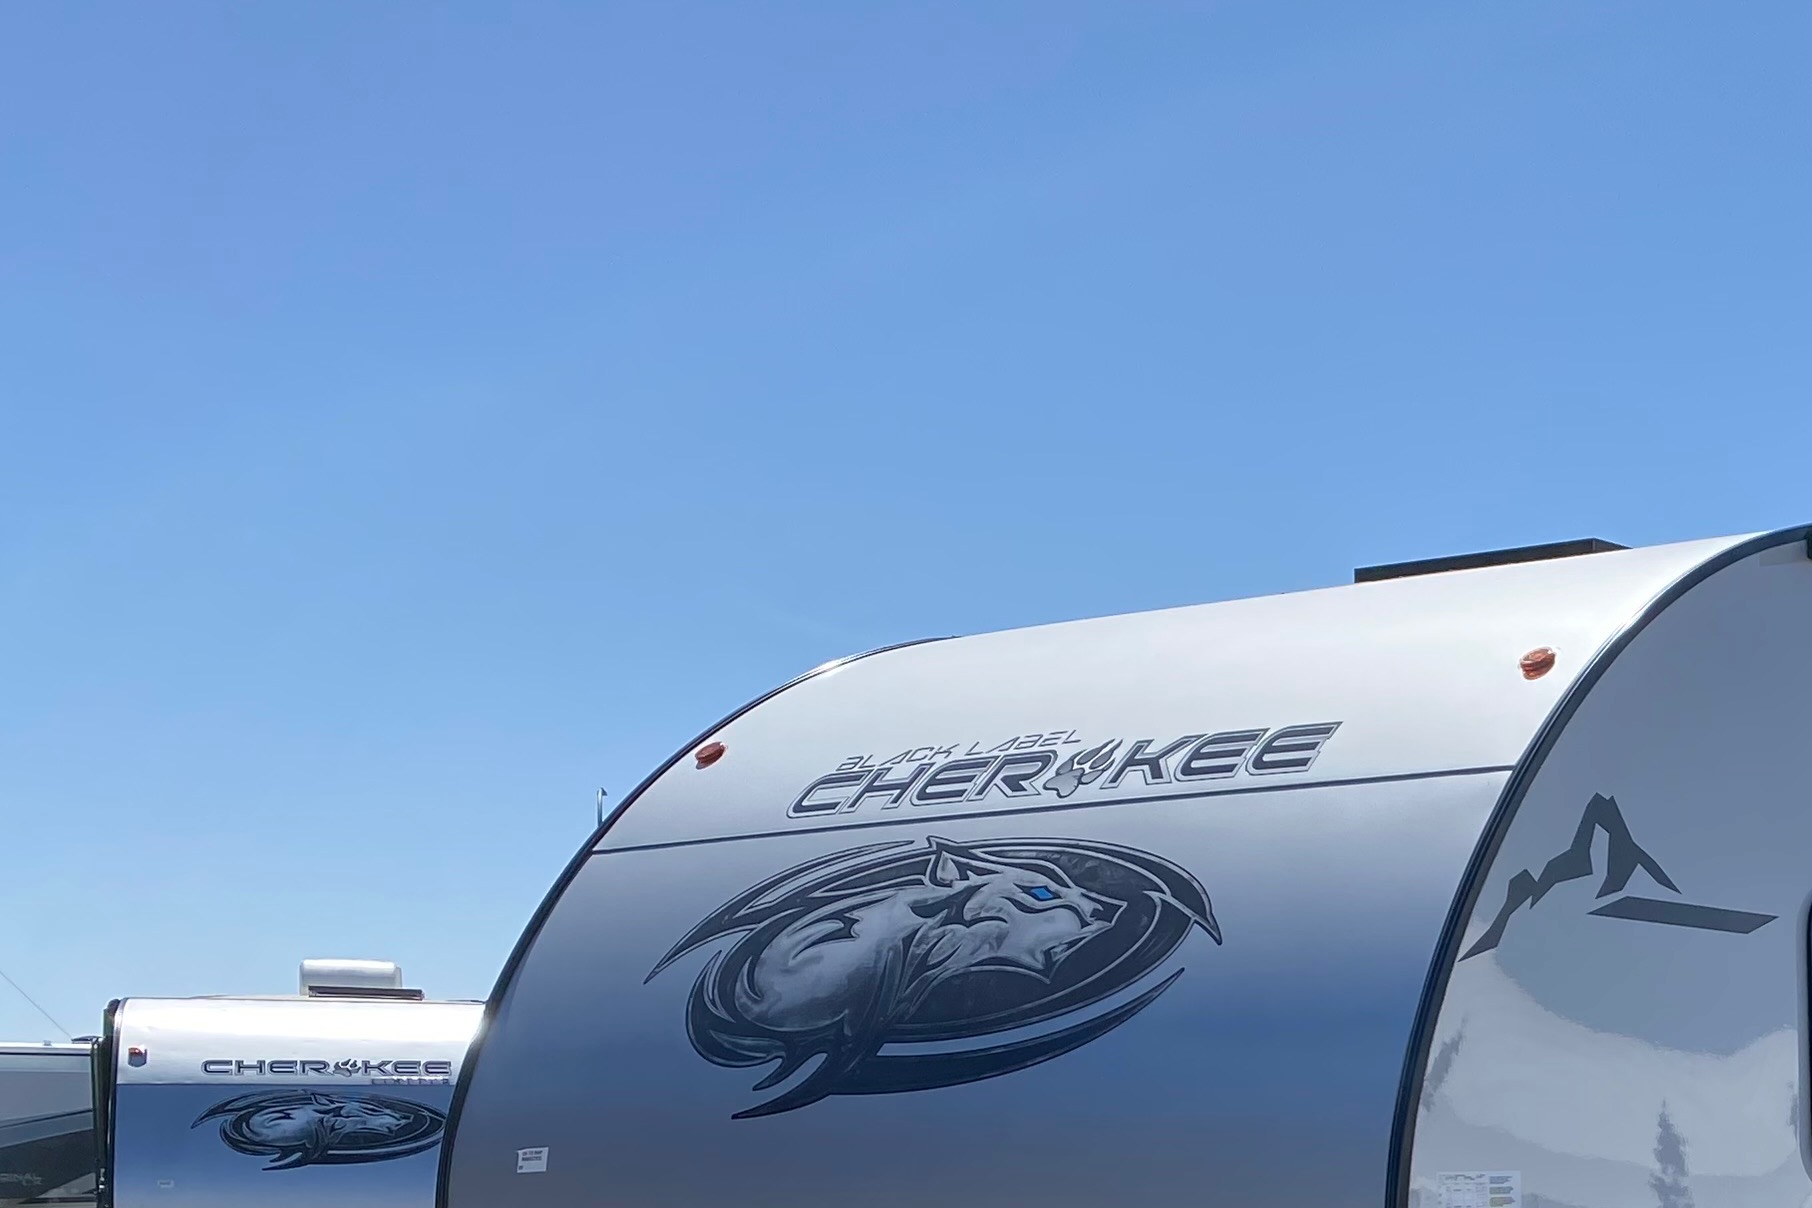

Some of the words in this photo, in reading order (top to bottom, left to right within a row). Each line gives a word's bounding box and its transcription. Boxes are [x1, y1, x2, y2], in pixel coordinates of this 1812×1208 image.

[786, 720, 1344, 819] CHEROKEE
[836, 743, 960, 772] BLACK
[968, 729, 1082, 753] LABEL
[202, 1059, 453, 1077] CHEROKEE
